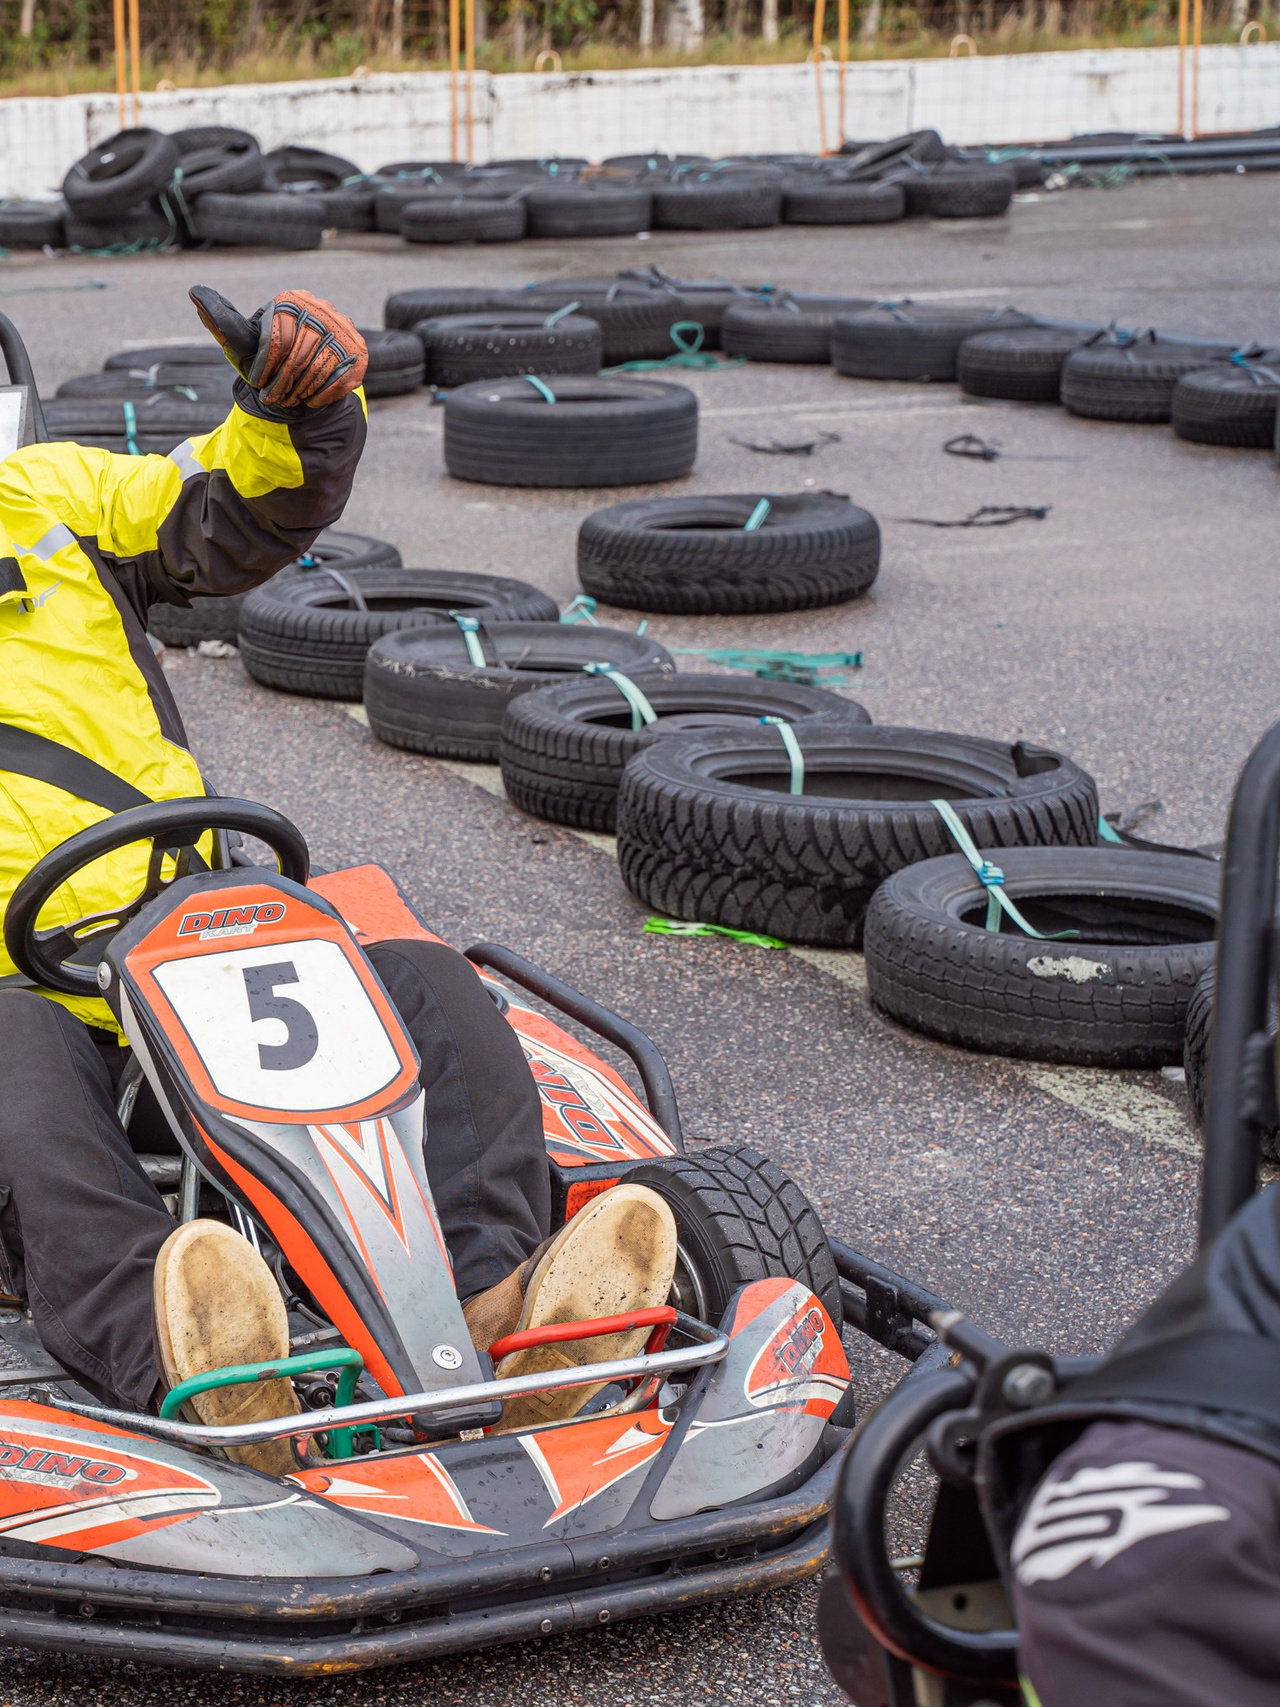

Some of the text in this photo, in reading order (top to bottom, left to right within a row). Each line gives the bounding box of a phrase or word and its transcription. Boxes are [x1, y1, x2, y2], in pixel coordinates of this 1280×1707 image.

[179, 903, 285, 935] DINO
[201, 923, 256, 939] KART
[241, 960, 319, 1071] 5
[523, 1048, 624, 1150] DIN
[779, 1309, 825, 1374] DINO
[2, 1469, 81, 1488] KART
